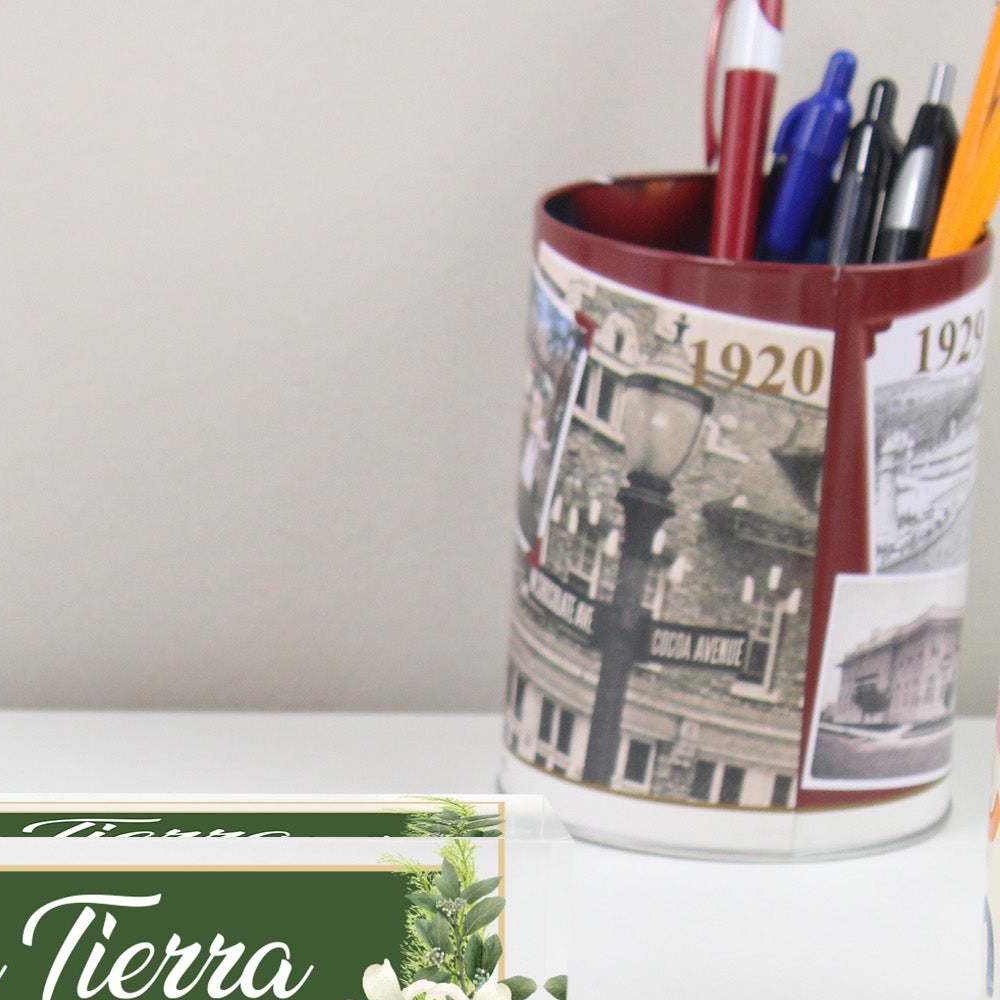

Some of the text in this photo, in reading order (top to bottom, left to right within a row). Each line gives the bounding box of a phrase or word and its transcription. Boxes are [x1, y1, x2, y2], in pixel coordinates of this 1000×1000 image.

[689, 338, 824, 396] 1920
[916, 309, 984, 374] 1929
[650, 628, 746, 668] COCOA AVENUE
